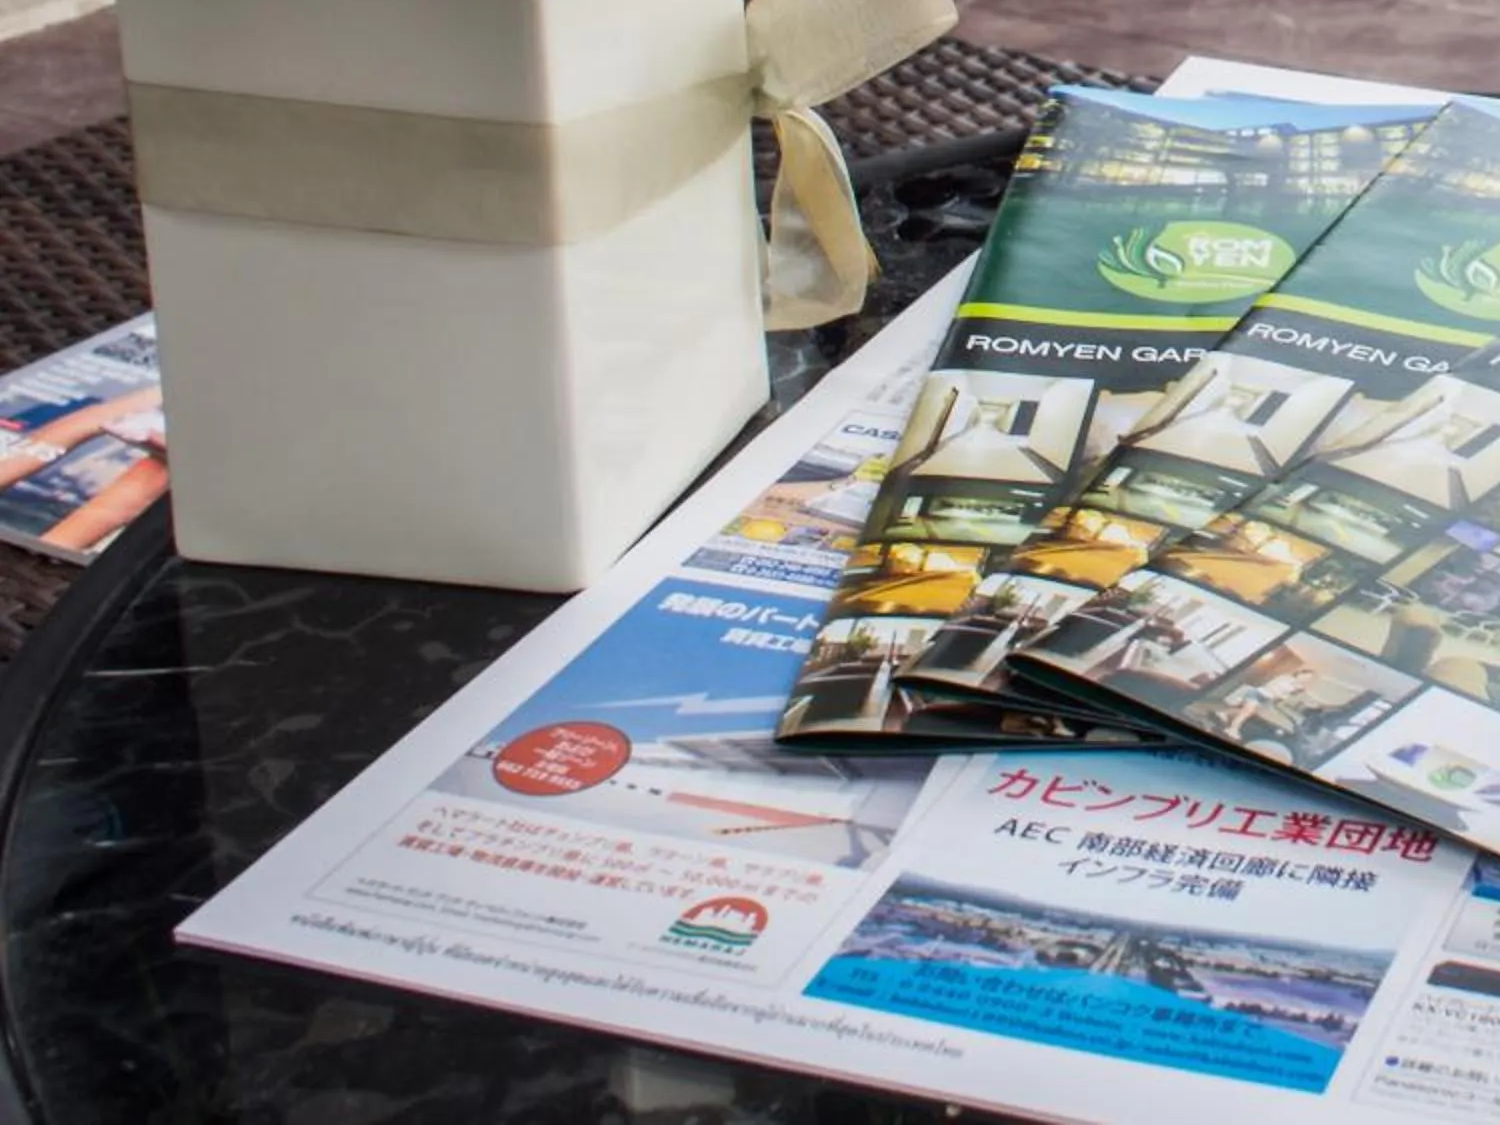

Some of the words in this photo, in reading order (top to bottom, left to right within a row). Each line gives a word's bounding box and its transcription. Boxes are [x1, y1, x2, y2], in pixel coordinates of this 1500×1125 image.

[965, 332, 1122, 363] ROMYEN
[1246, 321, 1398, 367] ROMYEN
[841, 423, 904, 441] CAS
[987, 767, 1439, 864] カビンブリ工業団地
[994, 816, 1070, 845] AEC
